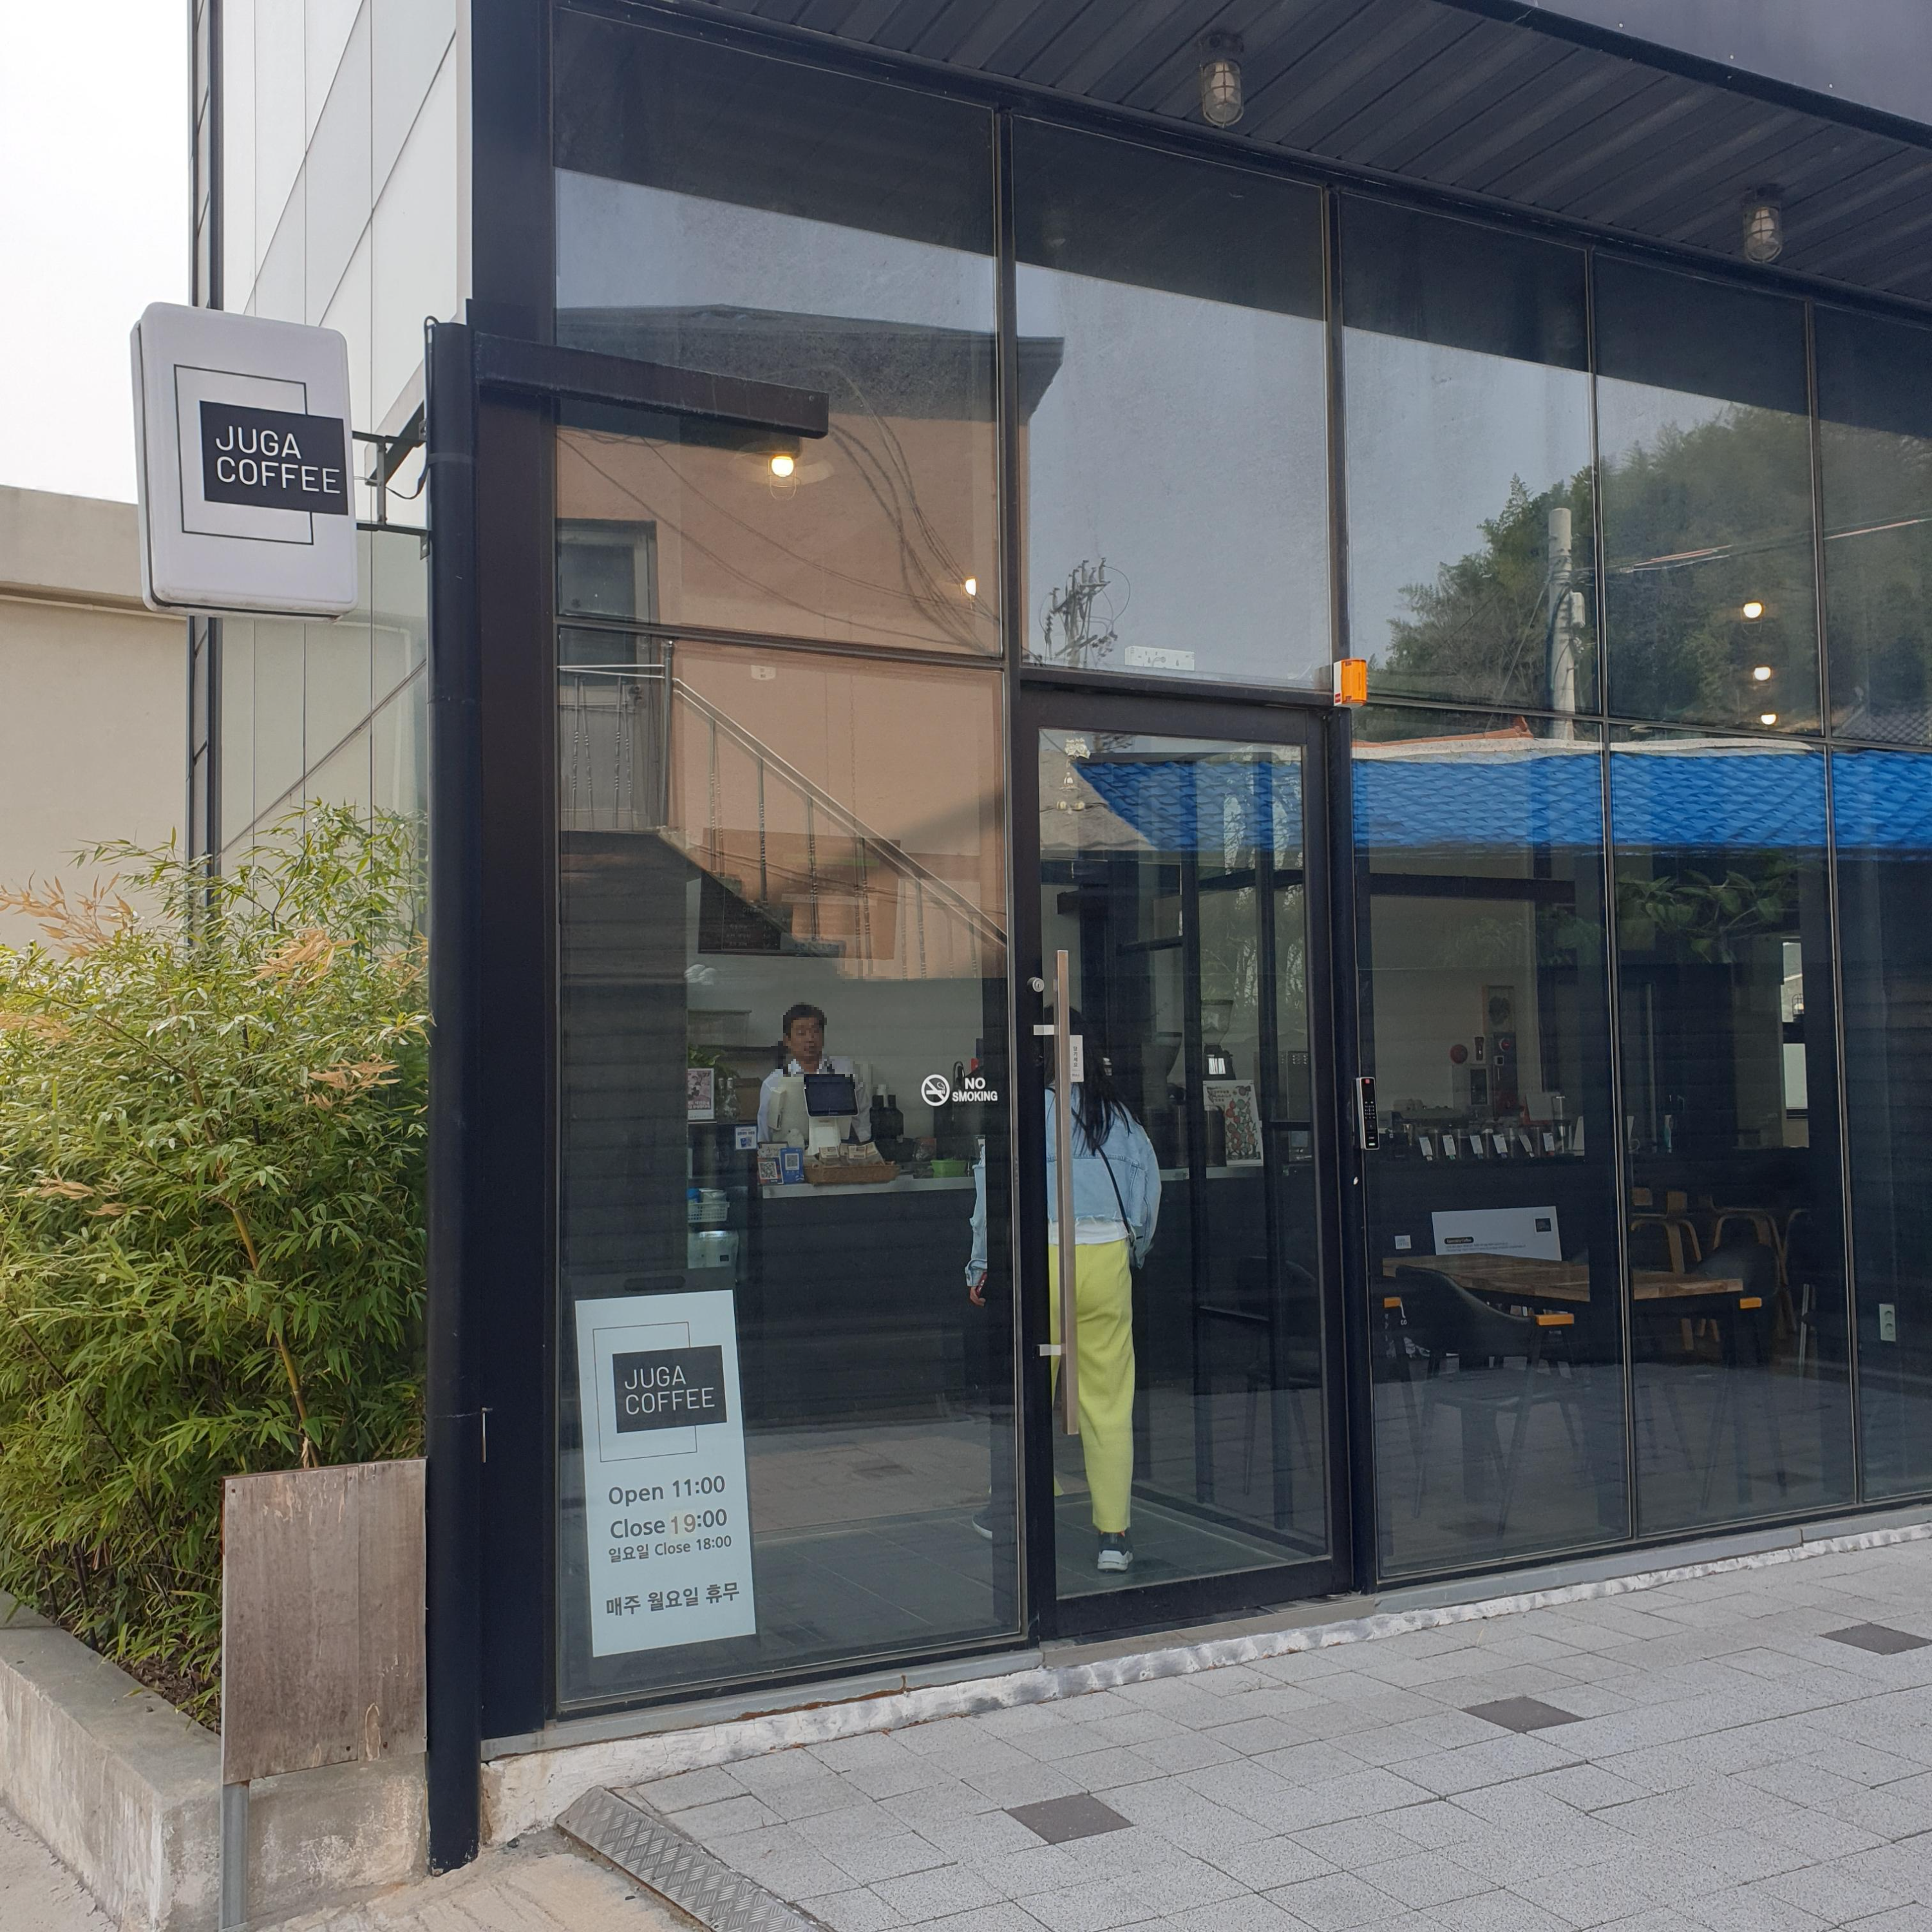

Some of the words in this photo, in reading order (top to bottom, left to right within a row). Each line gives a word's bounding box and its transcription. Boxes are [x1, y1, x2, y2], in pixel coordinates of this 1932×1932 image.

[216, 426, 301, 459] JUGA
[216, 456, 341, 494] COFFEE
[952, 1090, 998, 1102] SMOKING
[965, 1077, 986, 1090] NO
[624, 1365, 687, 1390] JUGA
[625, 1387, 715, 1415] COFFEE
[609, 1486, 664, 1507] Open
[672, 1475, 725, 1498] 11:00
[610, 1518, 666, 1539] Close
[670, 1508, 728, 1535] 19:00
[608, 1544, 649, 1564] 일요일
[654, 1542, 691, 1556] Close
[696, 1535, 732, 1551] 18:00
[606, 1594, 642, 1616] 매주
[647, 1586, 699, 1612] 월요일
[705, 1582, 740, 1604] 휴무
